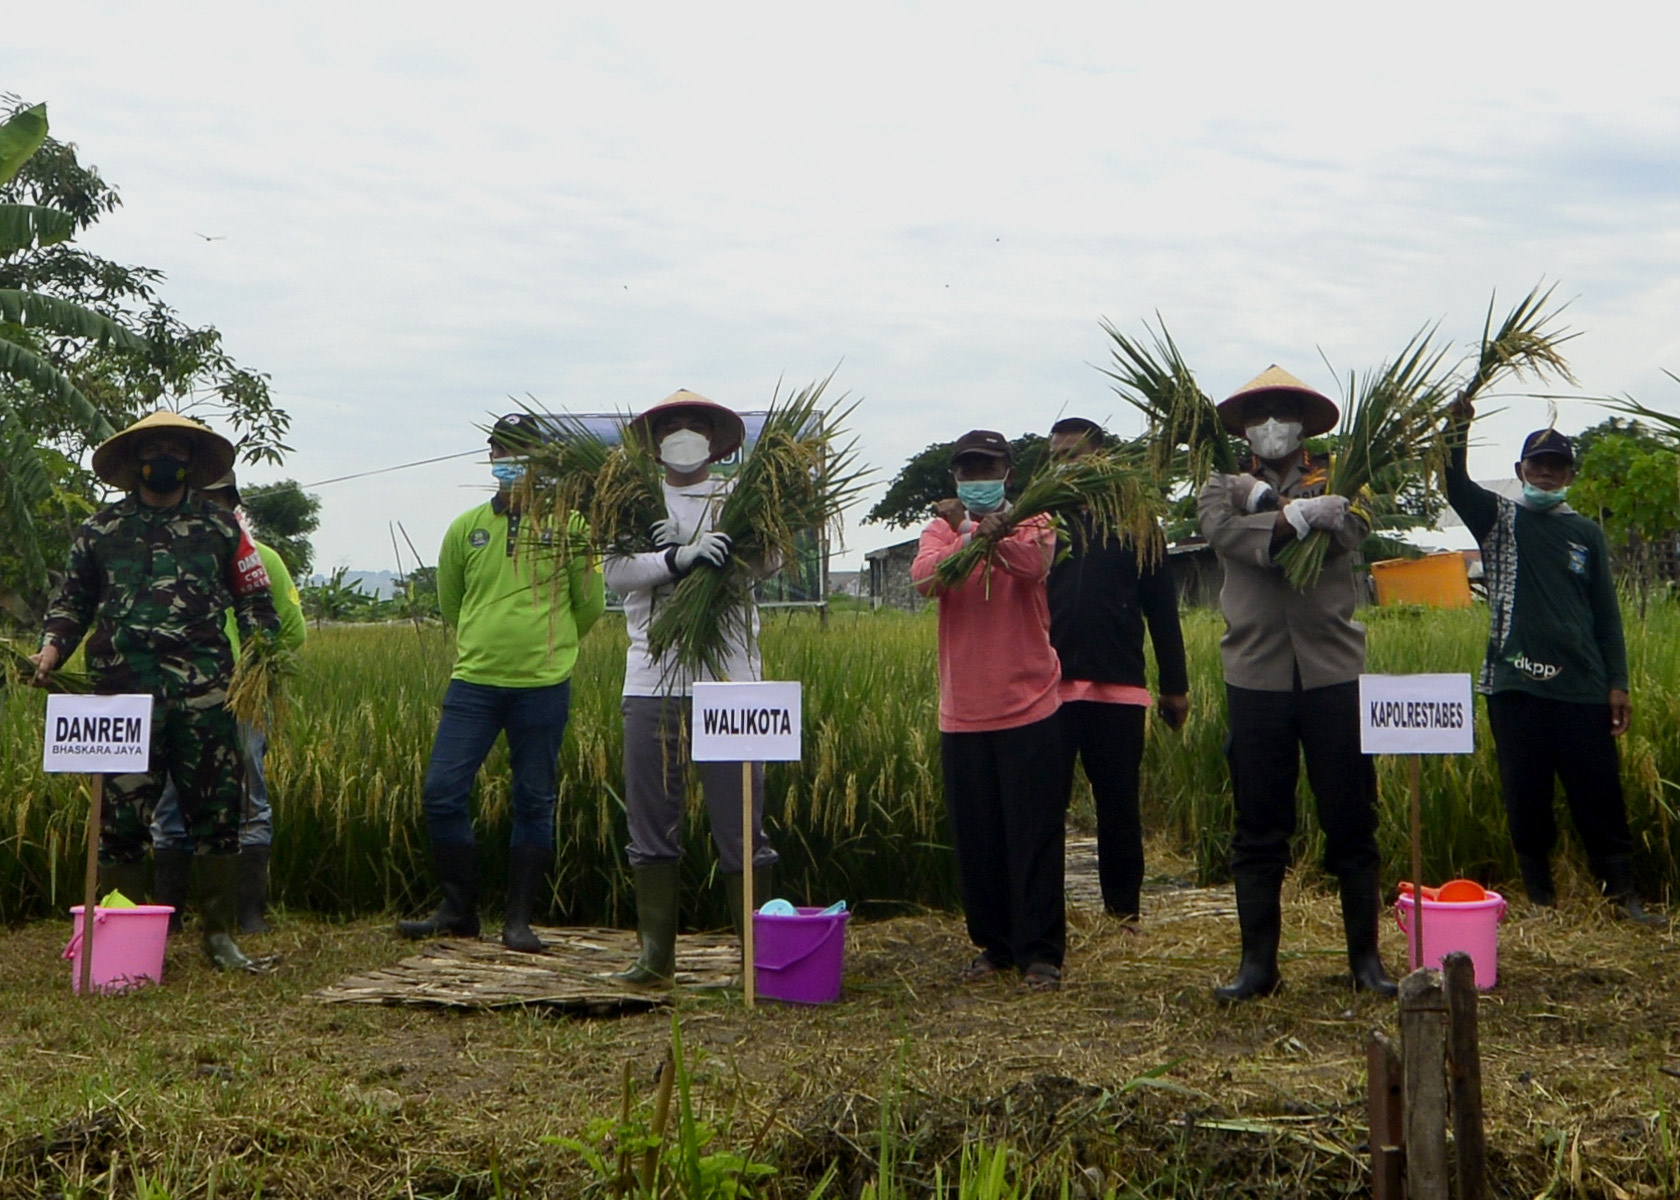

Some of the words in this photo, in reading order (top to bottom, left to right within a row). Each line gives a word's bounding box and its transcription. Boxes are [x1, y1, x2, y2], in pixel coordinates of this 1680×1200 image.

[1514, 656, 1556, 678] dkpp
[703, 708, 792, 735] WALIKOTA
[1370, 701, 1464, 729] KAPOLRESTABES
[55, 716, 142, 743] DANREM
[52, 744, 111, 755] BHASKARA
[114, 745, 143, 755] JAYA
